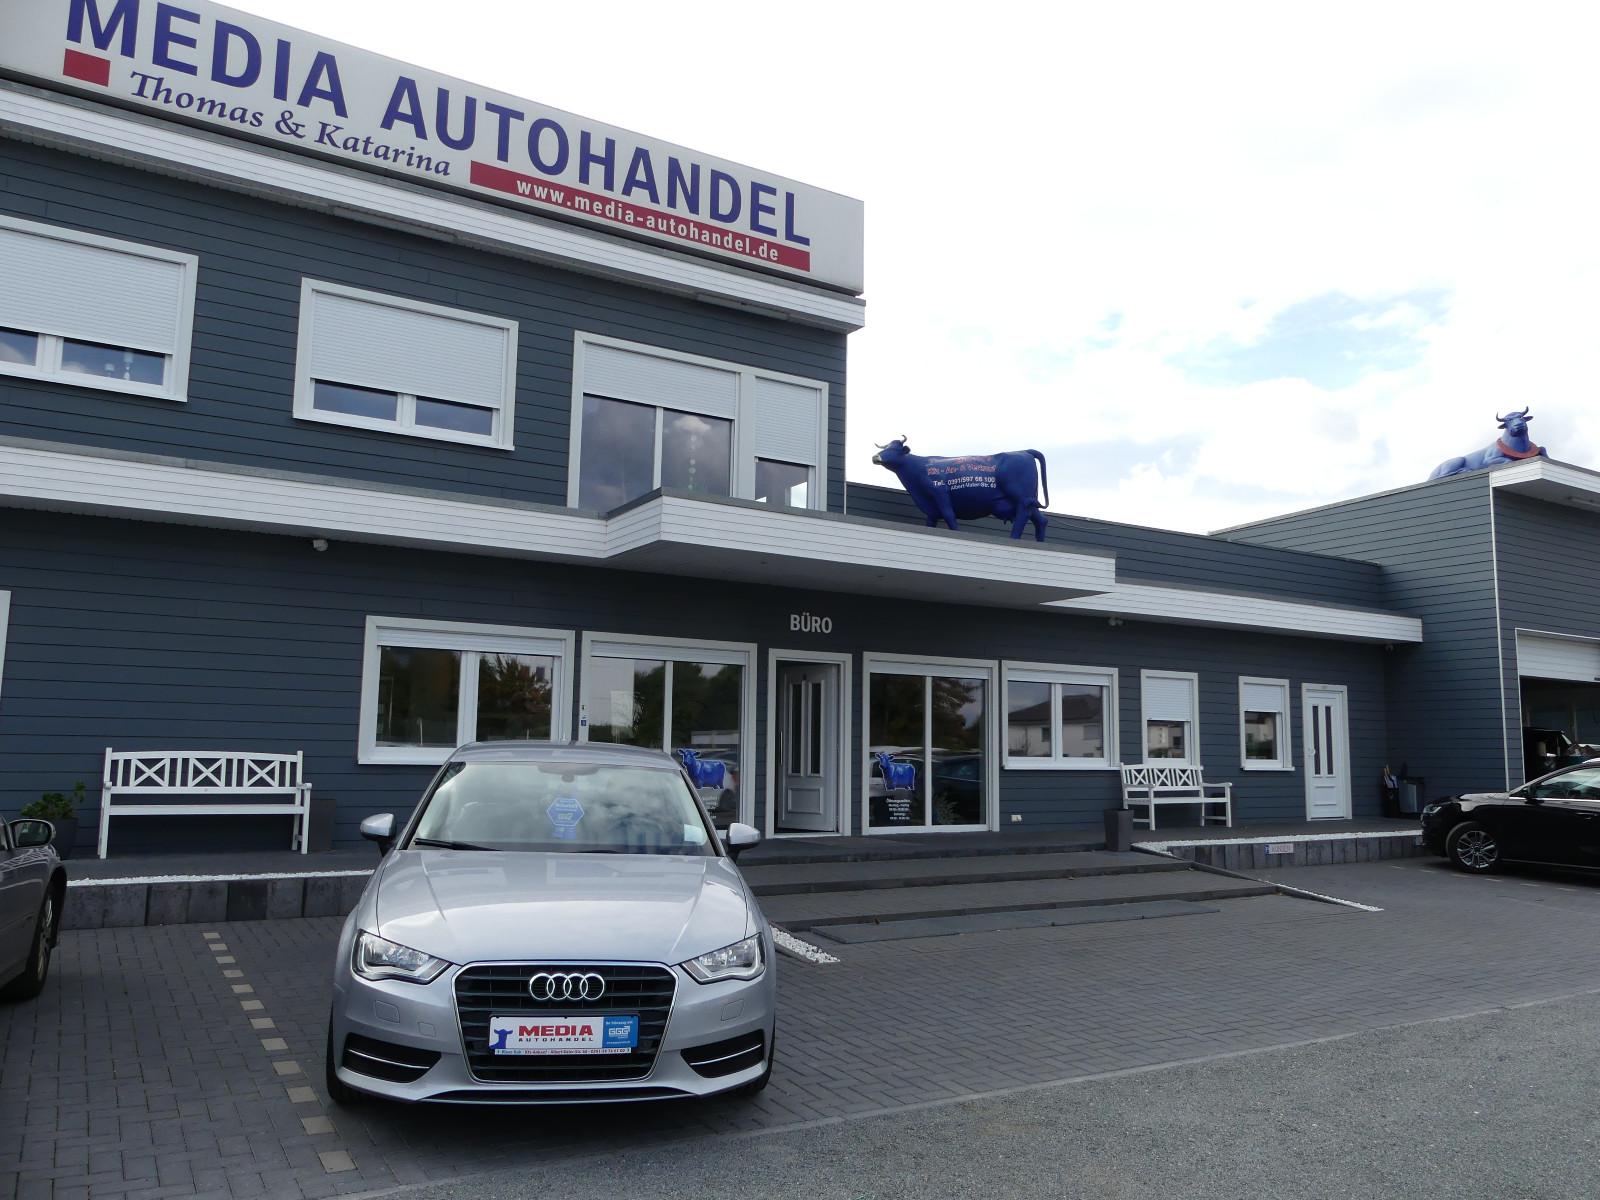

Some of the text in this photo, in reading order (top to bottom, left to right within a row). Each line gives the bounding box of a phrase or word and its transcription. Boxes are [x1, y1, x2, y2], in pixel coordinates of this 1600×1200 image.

[66, 0, 810, 246] MEDIA AUTOHANDEL
[130, 71, 451, 176] Thomas & Katarina
[516, 178, 779, 262] www.media-autohandel.de
[790, 612, 832, 634] BÜRO
[518, 1025, 593, 1036] MEDIA
